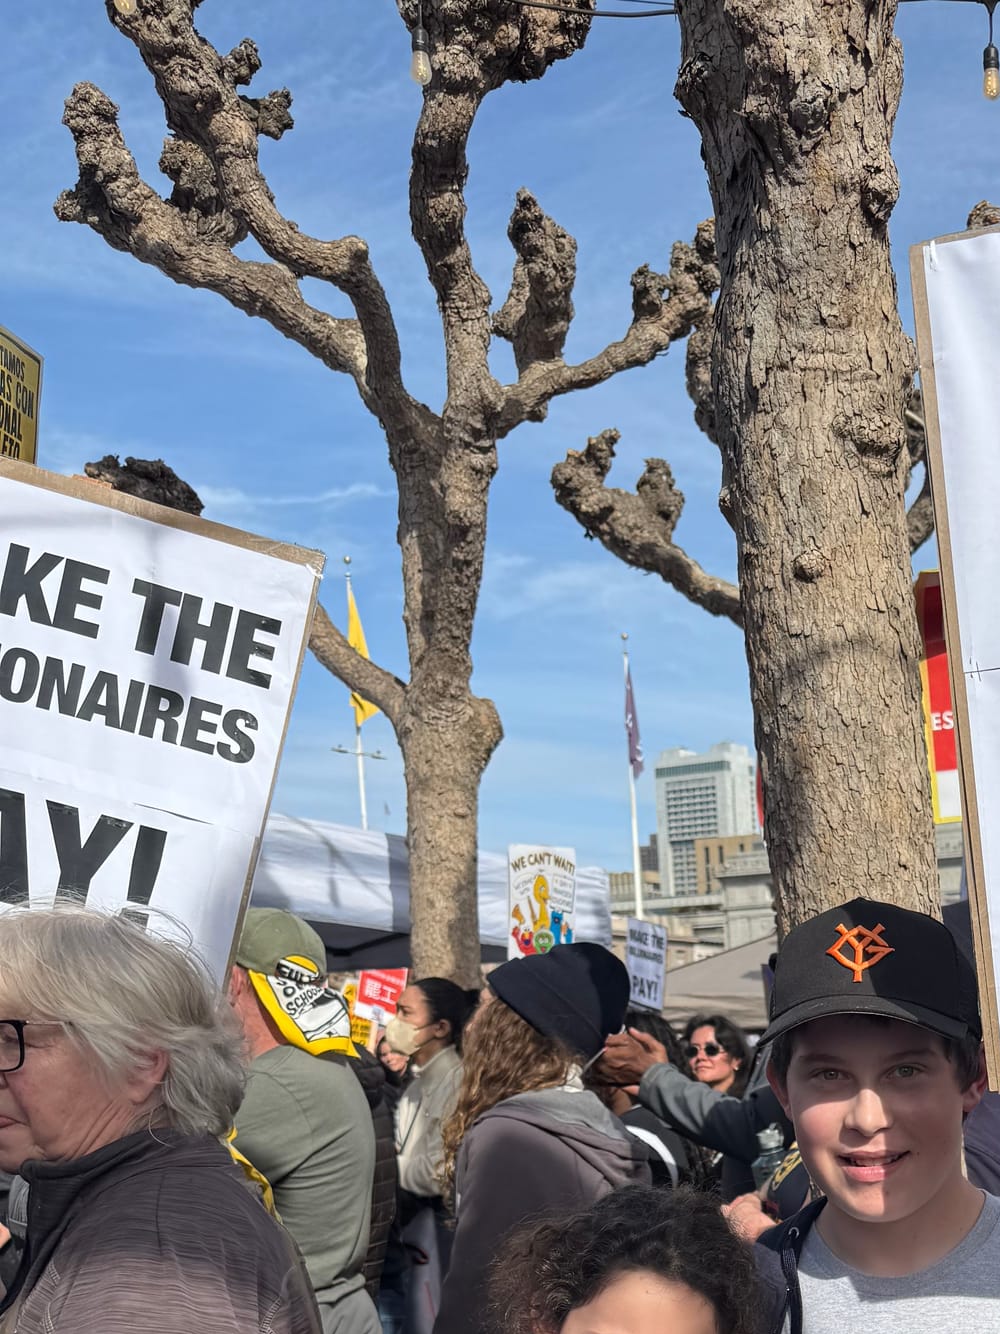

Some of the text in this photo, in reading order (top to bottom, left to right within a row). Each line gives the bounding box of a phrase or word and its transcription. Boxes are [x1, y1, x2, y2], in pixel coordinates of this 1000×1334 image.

[16, 382, 34, 419] CON
[132, 578, 282, 690] THE
[0, 644, 259, 764] ONAIRES
[511, 856, 527, 872] WE
[632, 975, 658, 1001] PAY!
